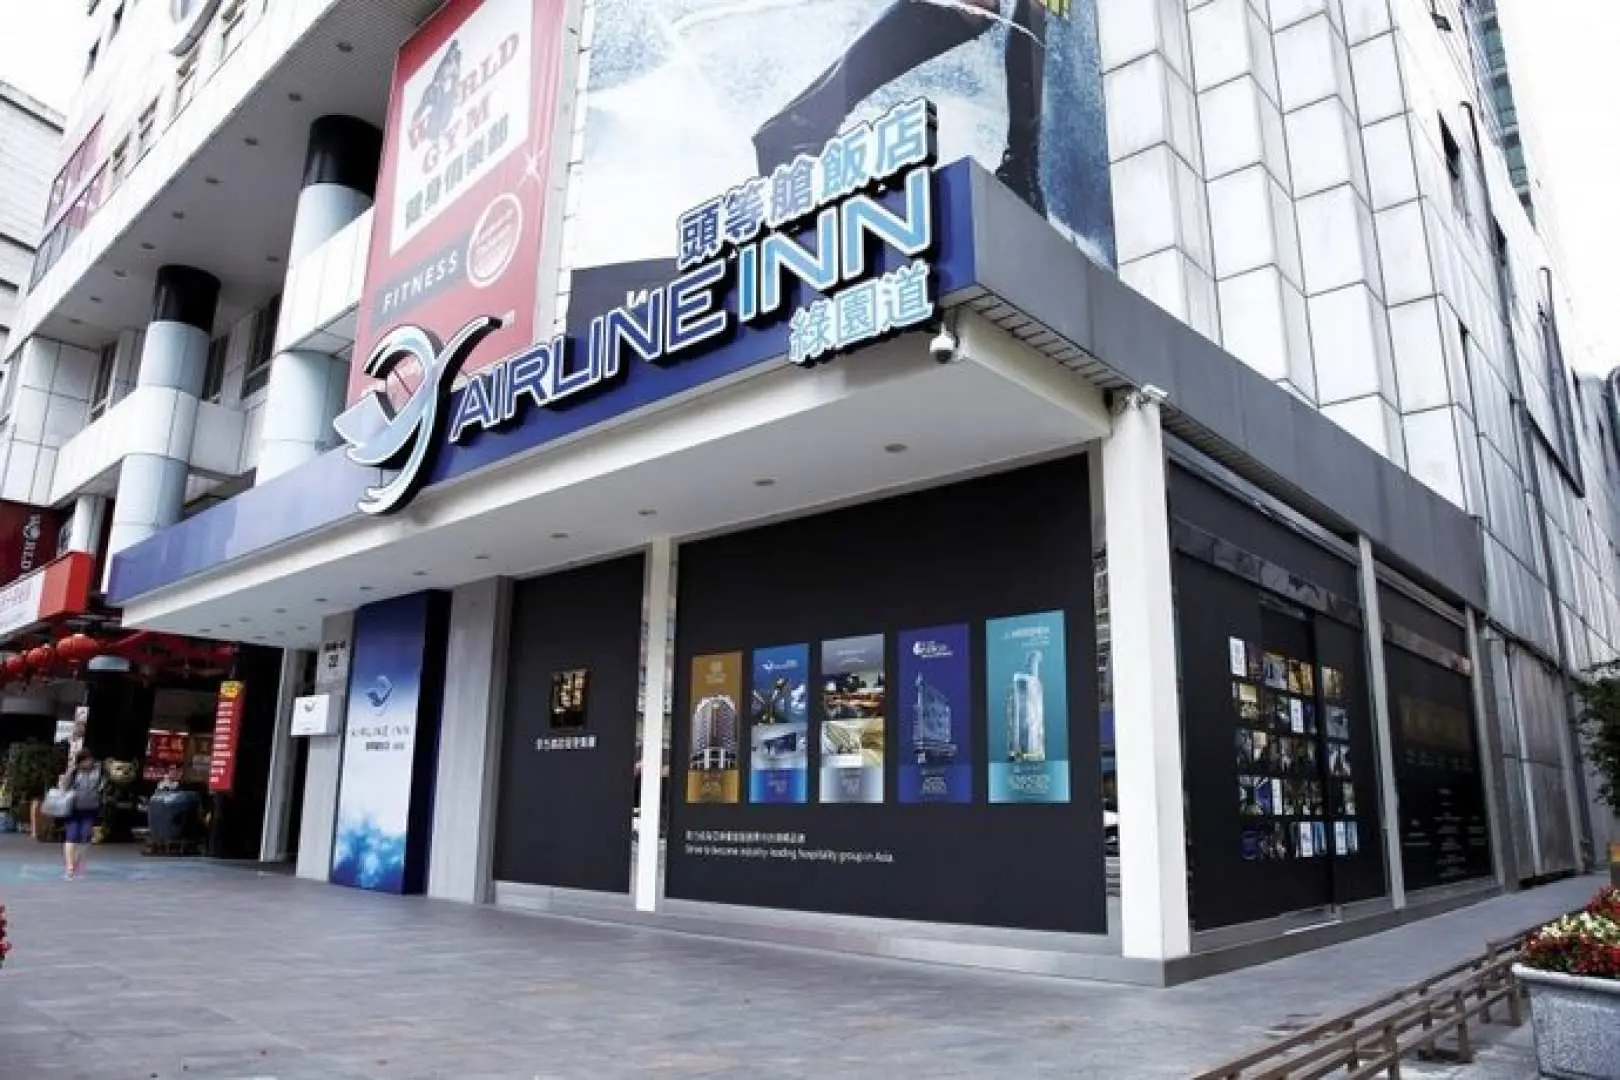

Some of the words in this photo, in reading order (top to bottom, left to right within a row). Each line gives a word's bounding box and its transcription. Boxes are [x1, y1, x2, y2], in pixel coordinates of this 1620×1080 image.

[421, 93, 491, 175] GYM
[676, 97, 936, 271] 頭等艙飯店
[381, 249, 460, 315] FITNESS
[448, 258, 730, 445] AIRLINE
[738, 165, 933, 324] INN
[788, 259, 935, 365] 綠園道
